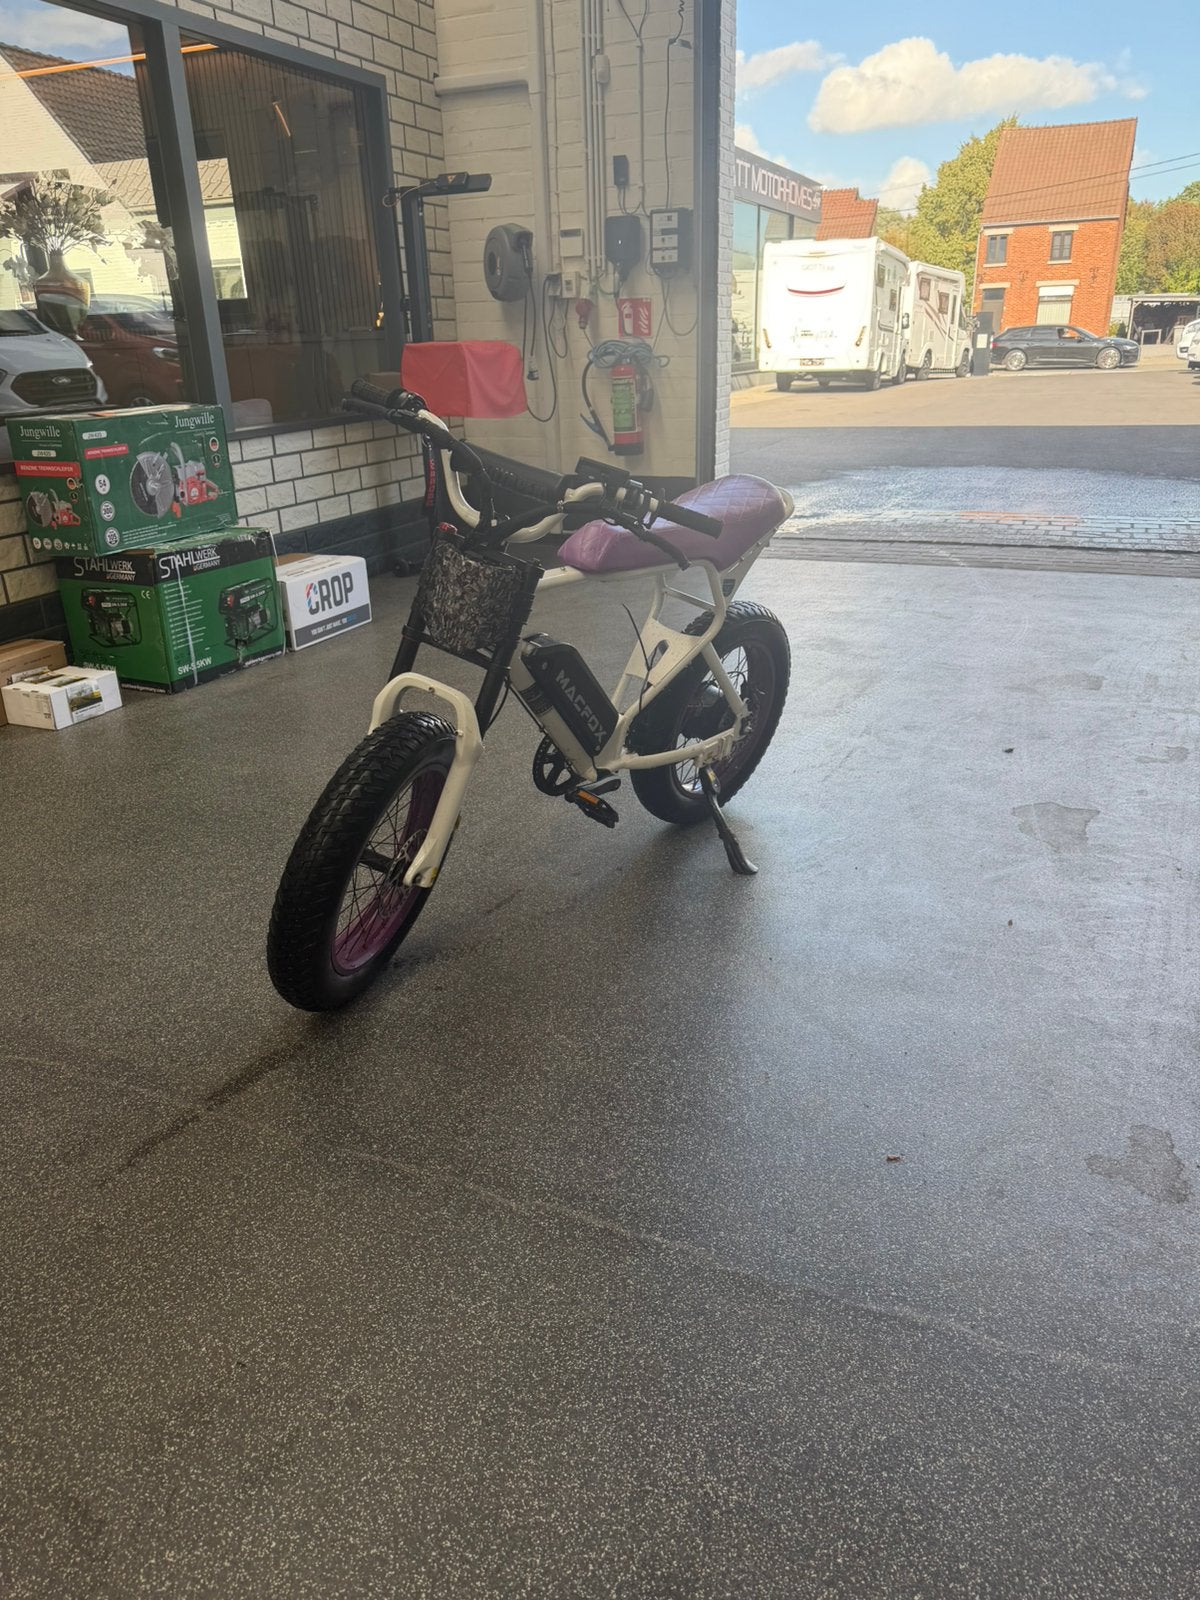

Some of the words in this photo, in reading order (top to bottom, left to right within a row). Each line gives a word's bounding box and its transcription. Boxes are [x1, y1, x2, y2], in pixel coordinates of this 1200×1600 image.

[750, 163, 812, 211] MOTORHOMES
[174, 411, 215, 430] Jungwille
[19, 425, 61, 440] Jungwille
[98, 479, 107, 489] 54
[73, 556, 133, 577] STAHLWERK
[158, 547, 219, 579] STAHLWERK
[196, 559, 221, 571] GERMANY
[110, 573, 136, 582] GERMANY
[304, 571, 354, 615] CROP
[555, 669, 607, 743] MACFOX
